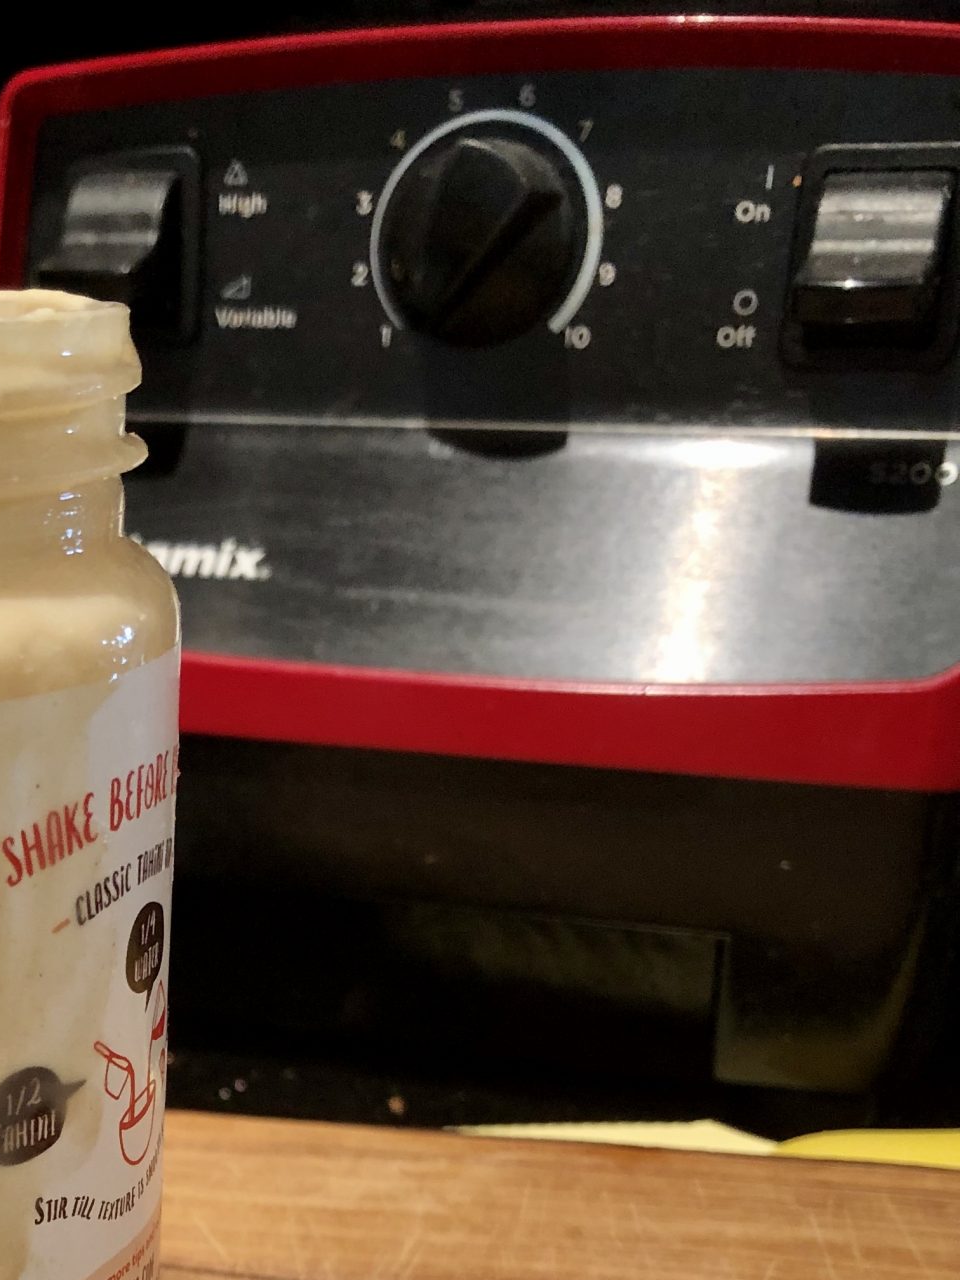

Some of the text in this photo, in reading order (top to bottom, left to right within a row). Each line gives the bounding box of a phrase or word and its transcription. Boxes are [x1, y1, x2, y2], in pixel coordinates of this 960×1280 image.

[448, 88, 463, 112] 5
[391, 129, 407, 150] 4
[578, 118, 593, 142] 7
[218, 192, 267, 218] High
[355, 190, 372, 215] 3
[605, 183, 623, 209] 8
[735, 200, 771, 223] On
[351, 262, 368, 286] 2
[599, 262, 616, 286] 9
[215, 306, 297, 328] Variable
[564, 325, 591, 349] 10
[717, 324, 756, 348] Off
[2, 792, 98, 887] SHAKE
[109, 750, 168, 832] BEFORE
[6, 1077, 42, 1116] 1/2
[34, 1196, 68, 1225] STIR
[98, 1186, 135, 1221] TEXTURE
[132, 1247, 145, 1267] tips
